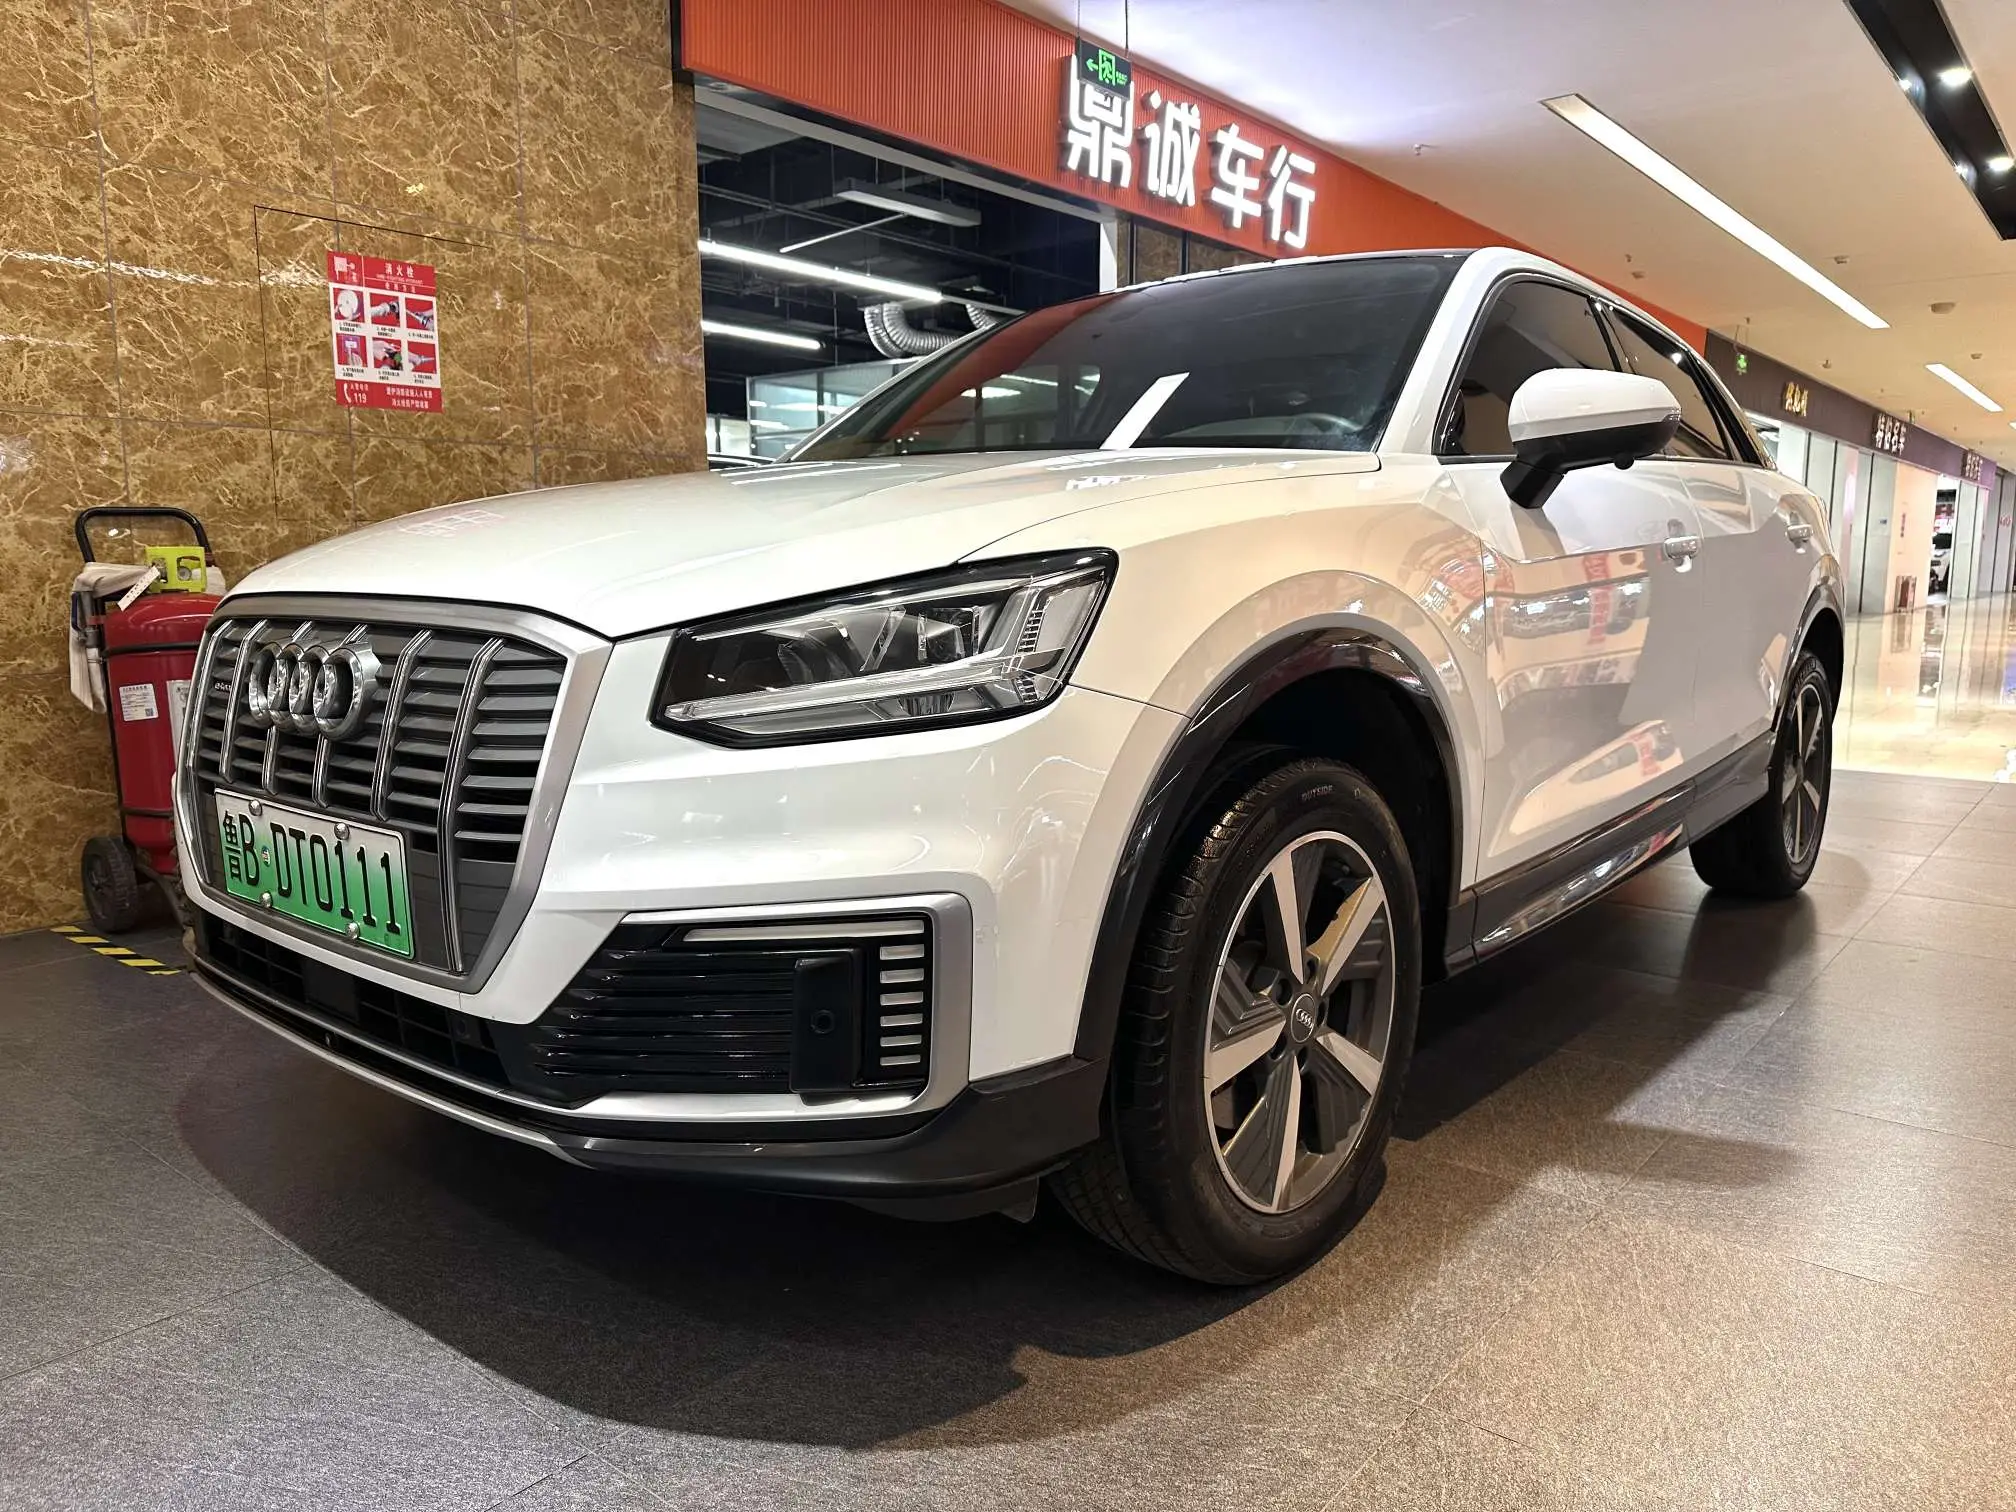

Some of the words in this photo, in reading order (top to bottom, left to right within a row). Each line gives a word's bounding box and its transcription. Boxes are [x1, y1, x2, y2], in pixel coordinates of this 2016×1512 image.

[1067, 54, 1316, 249] 鼎诚车行
[354, 393, 367, 404] 119
